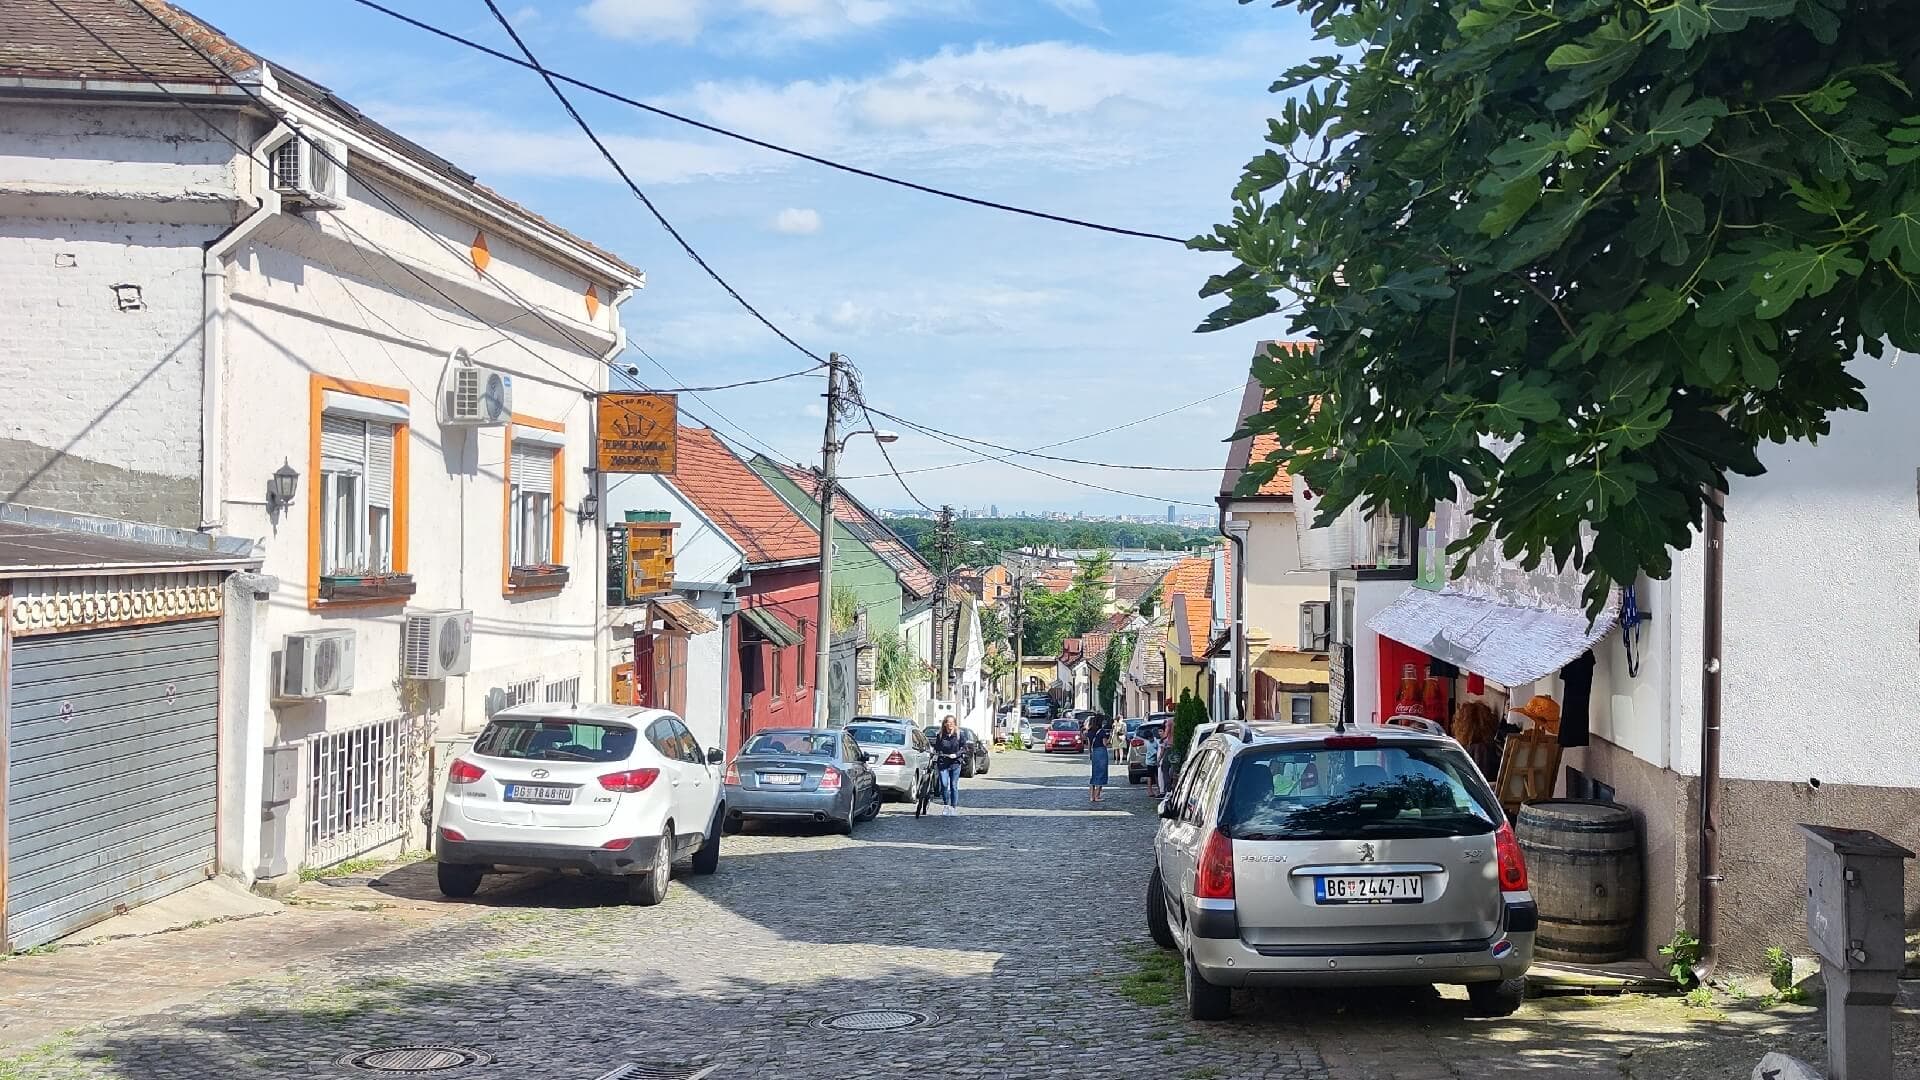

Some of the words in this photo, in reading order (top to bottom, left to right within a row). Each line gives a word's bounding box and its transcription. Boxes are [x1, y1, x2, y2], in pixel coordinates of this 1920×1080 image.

[513, 785, 526, 797] BG
[1240, 855, 1288, 863] PEUGEOT
[1327, 879, 1346, 897] BG
